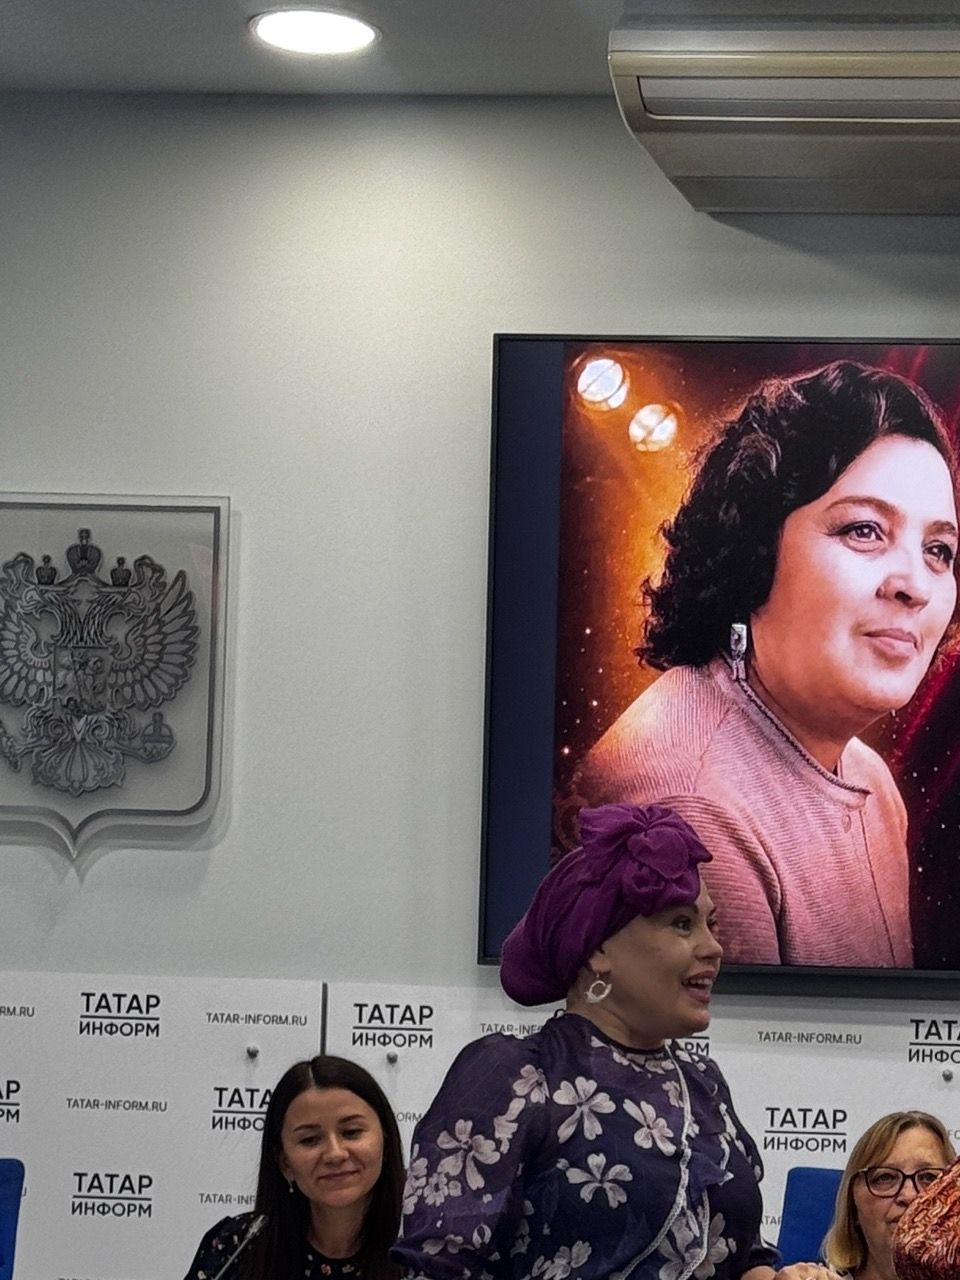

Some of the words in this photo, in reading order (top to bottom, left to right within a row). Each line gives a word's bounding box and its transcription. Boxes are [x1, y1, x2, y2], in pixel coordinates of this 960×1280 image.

[81, 992, 161, 1015] ТАТАР
[206, 1012, 308, 1026] TATAR-INFORM.RU
[353, 1003, 433, 1025] ТАТАР
[79, 1020, 160, 1038] ИНФОРМ
[352, 1032, 433, 1048] ИНФОРМ
[757, 1031, 862, 1045] TATAR-INFORM.RU
[66, 1098, 168, 1112] TATAR-INFORM.RU
[213, 1087, 273, 1108] ТАТА
[212, 1116, 265, 1131] ИНФО
[765, 1107, 847, 1129] ТАТАР
[763, 1136, 847, 1153] ИНФОРМ
[73, 1172, 153, 1195] ТАТАР
[198, 1192, 256, 1205] TATAR-INF
[71, 1201, 152, 1218] ИНФОРМ
